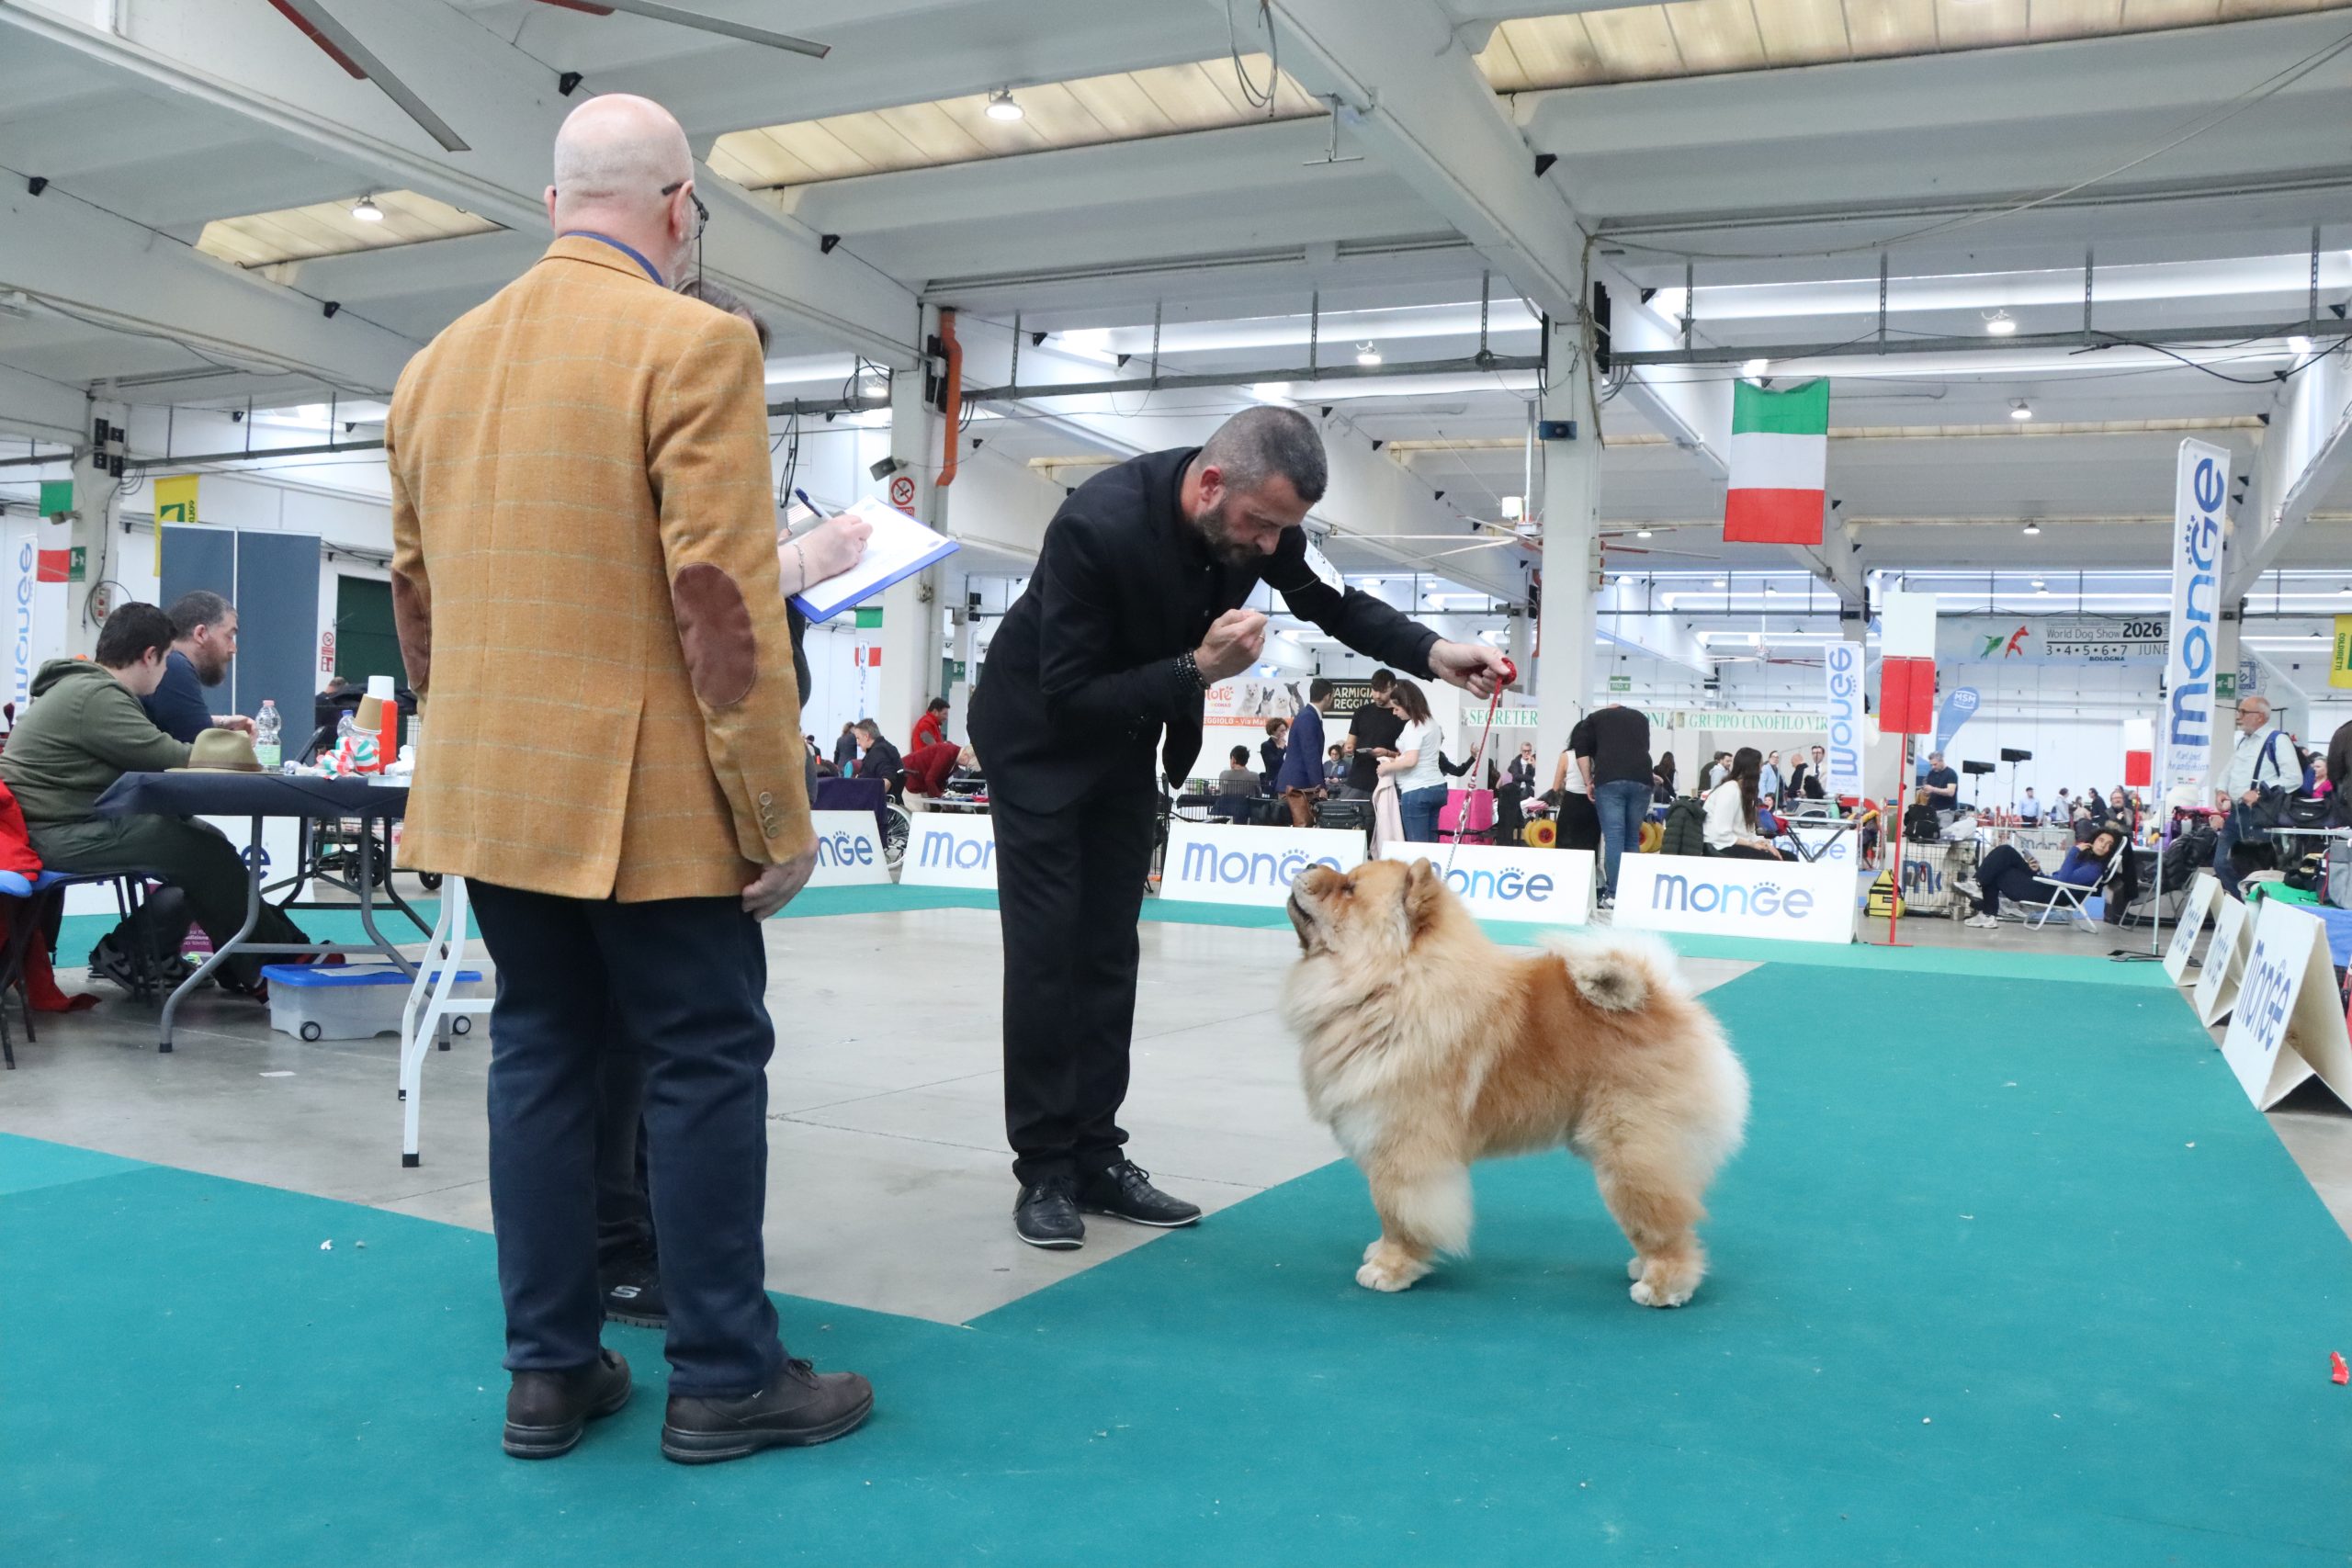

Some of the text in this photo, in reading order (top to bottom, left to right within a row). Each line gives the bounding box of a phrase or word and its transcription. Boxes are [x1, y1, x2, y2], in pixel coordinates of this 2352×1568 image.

[2046, 628, 2073, 639] World
[2075, 629, 2094, 641] Dog
[2096, 628, 2121, 639] Show
[2122, 622, 2163, 638] 2026
[2138, 644, 2169, 655] JUNE
[1689, 713, 1738, 728] GRUPPO
[1742, 714, 1804, 730] CINOFILO
